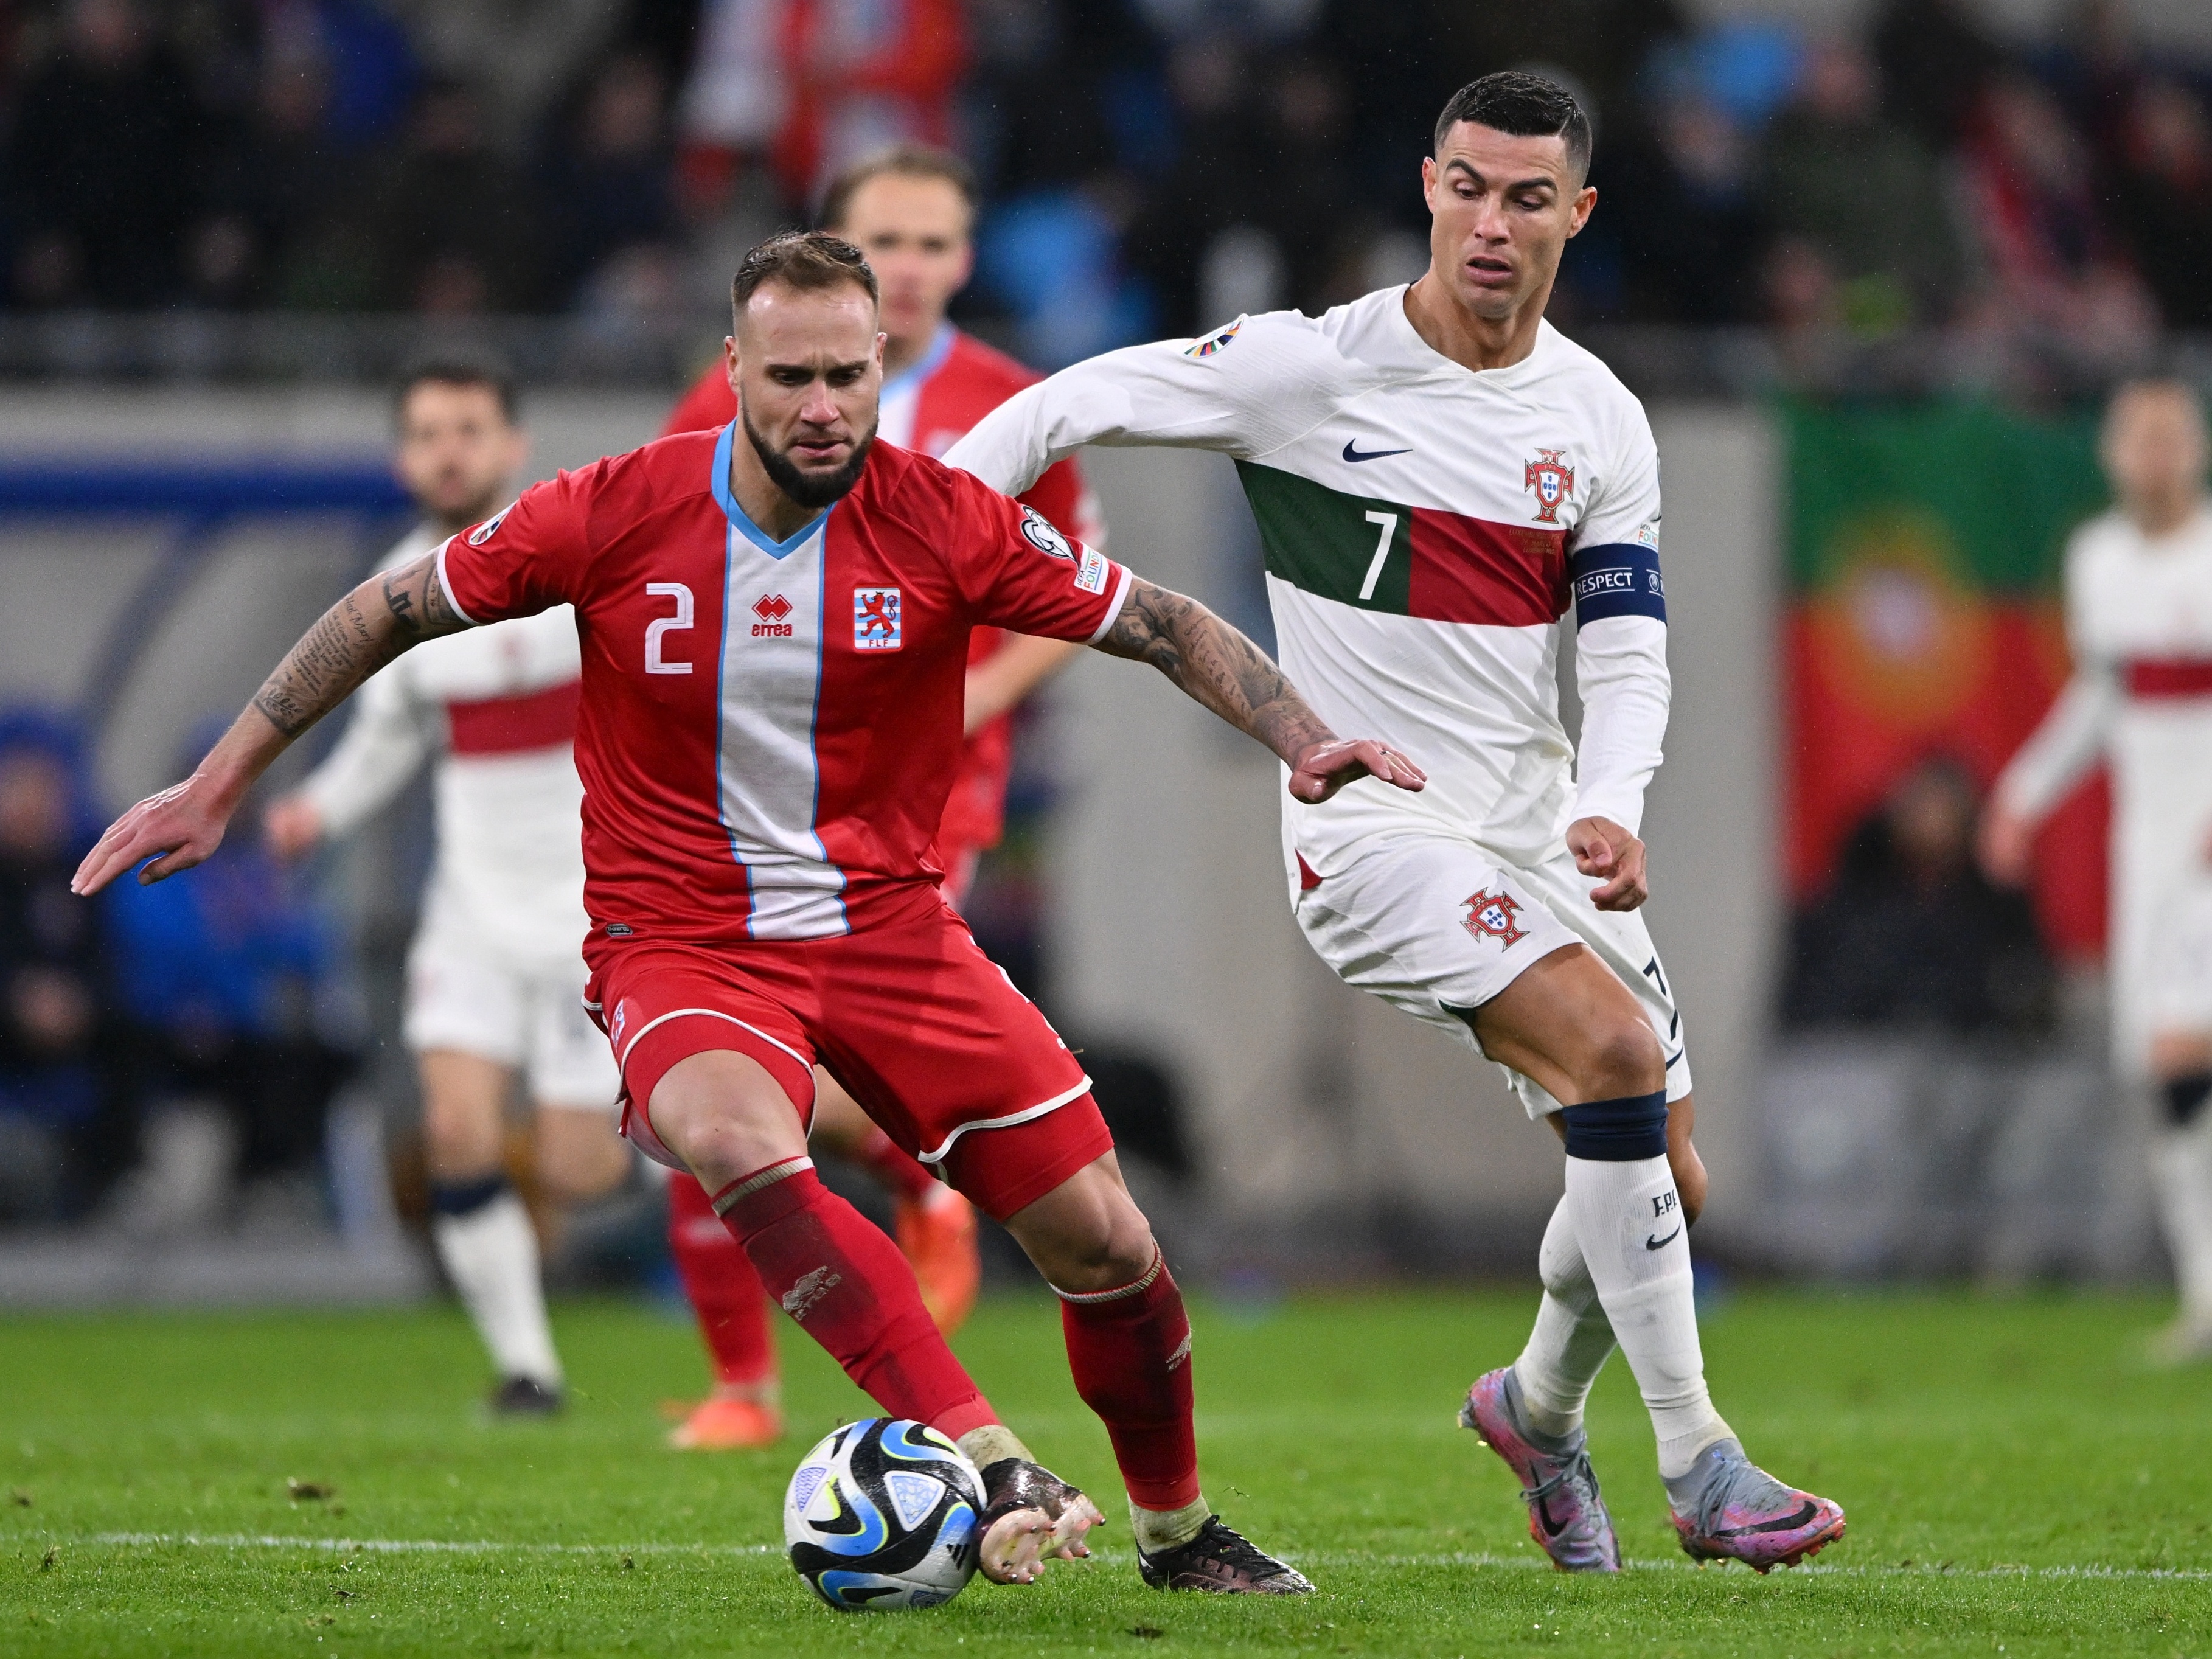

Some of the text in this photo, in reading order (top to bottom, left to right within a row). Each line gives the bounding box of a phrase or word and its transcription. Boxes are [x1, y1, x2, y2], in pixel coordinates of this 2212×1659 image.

[1358, 510, 1397, 600] 7
[1577, 572, 1632, 596] RESPECT
[645, 583, 694, 674] 2
[869, 639, 889, 647] FLF
